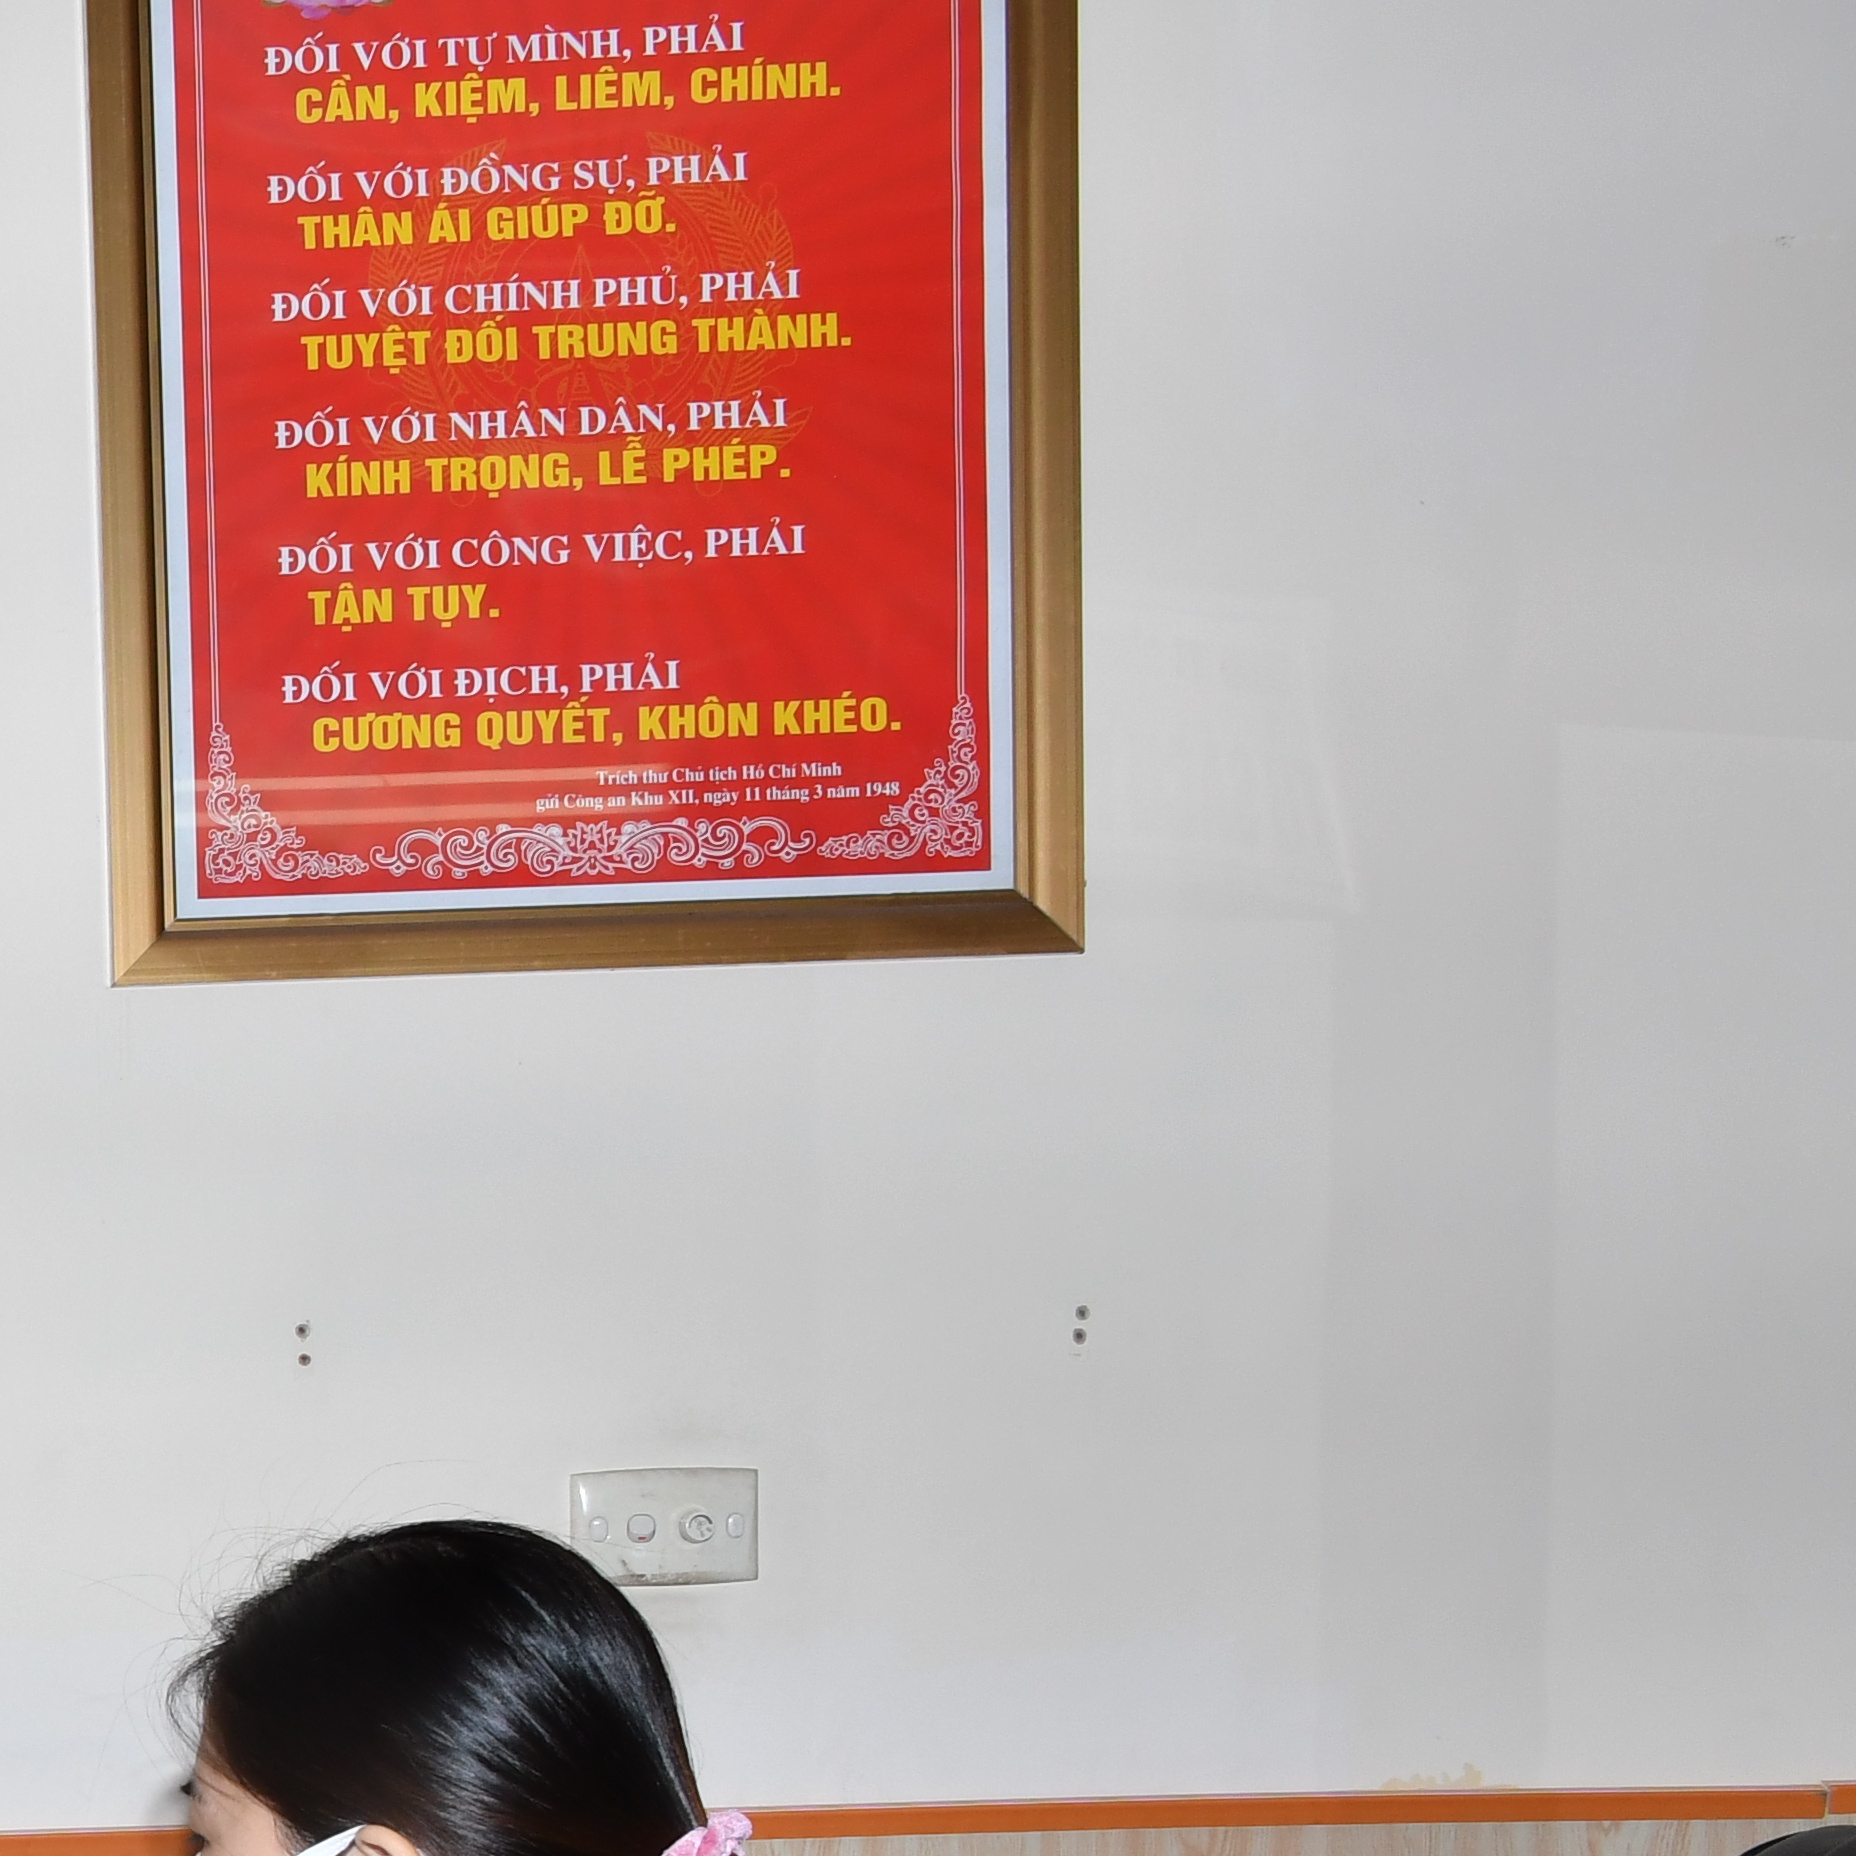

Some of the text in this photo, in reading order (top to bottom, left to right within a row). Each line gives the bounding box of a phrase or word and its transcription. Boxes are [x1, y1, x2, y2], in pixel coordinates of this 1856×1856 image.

[263, 13, 744, 77] ĐỐI VỚI TỰ MÌNH, PHẢI
[295, 61, 841, 125] CẦN, KIỆM, LIÊM, CHÍNH.
[274, 389, 787, 450] ĐỐI VỚI NHÂN DÂN, PHẢI
[306, 436, 791, 499] KÍNH TRỌNG, LỄ PHÉP.
[277, 516, 805, 576] ĐỐI VỚI CÔNG VIỆC, PHẢI
[307, 582, 500, 633] TẬN TỤY.
[281, 651, 680, 705] ĐỐI VỚI ĐỊCH, PHẢI
[312, 690, 901, 753] CƯƠNG QUYẾT, KHÔN KHÉO.
[563, 792, 604, 810] Công
[607, 795, 627, 808] an
[630, 790, 664, 807] Khu
[668, 789, 700, 807] XII,
[702, 788, 739, 806] ngày
[745, 786, 761, 802] 11
[765, 785, 809, 802] tháng
[813, 784, 823, 800] 3
[826, 784, 860, 798] năm
[865, 781, 901, 797] 1948
[596, 769, 639, 786] Trích
[642, 768, 668, 785] thư
[709, 765, 737, 784] tịch
[768, 762, 797, 779] Chí
[801, 762, 843, 777] Minh
